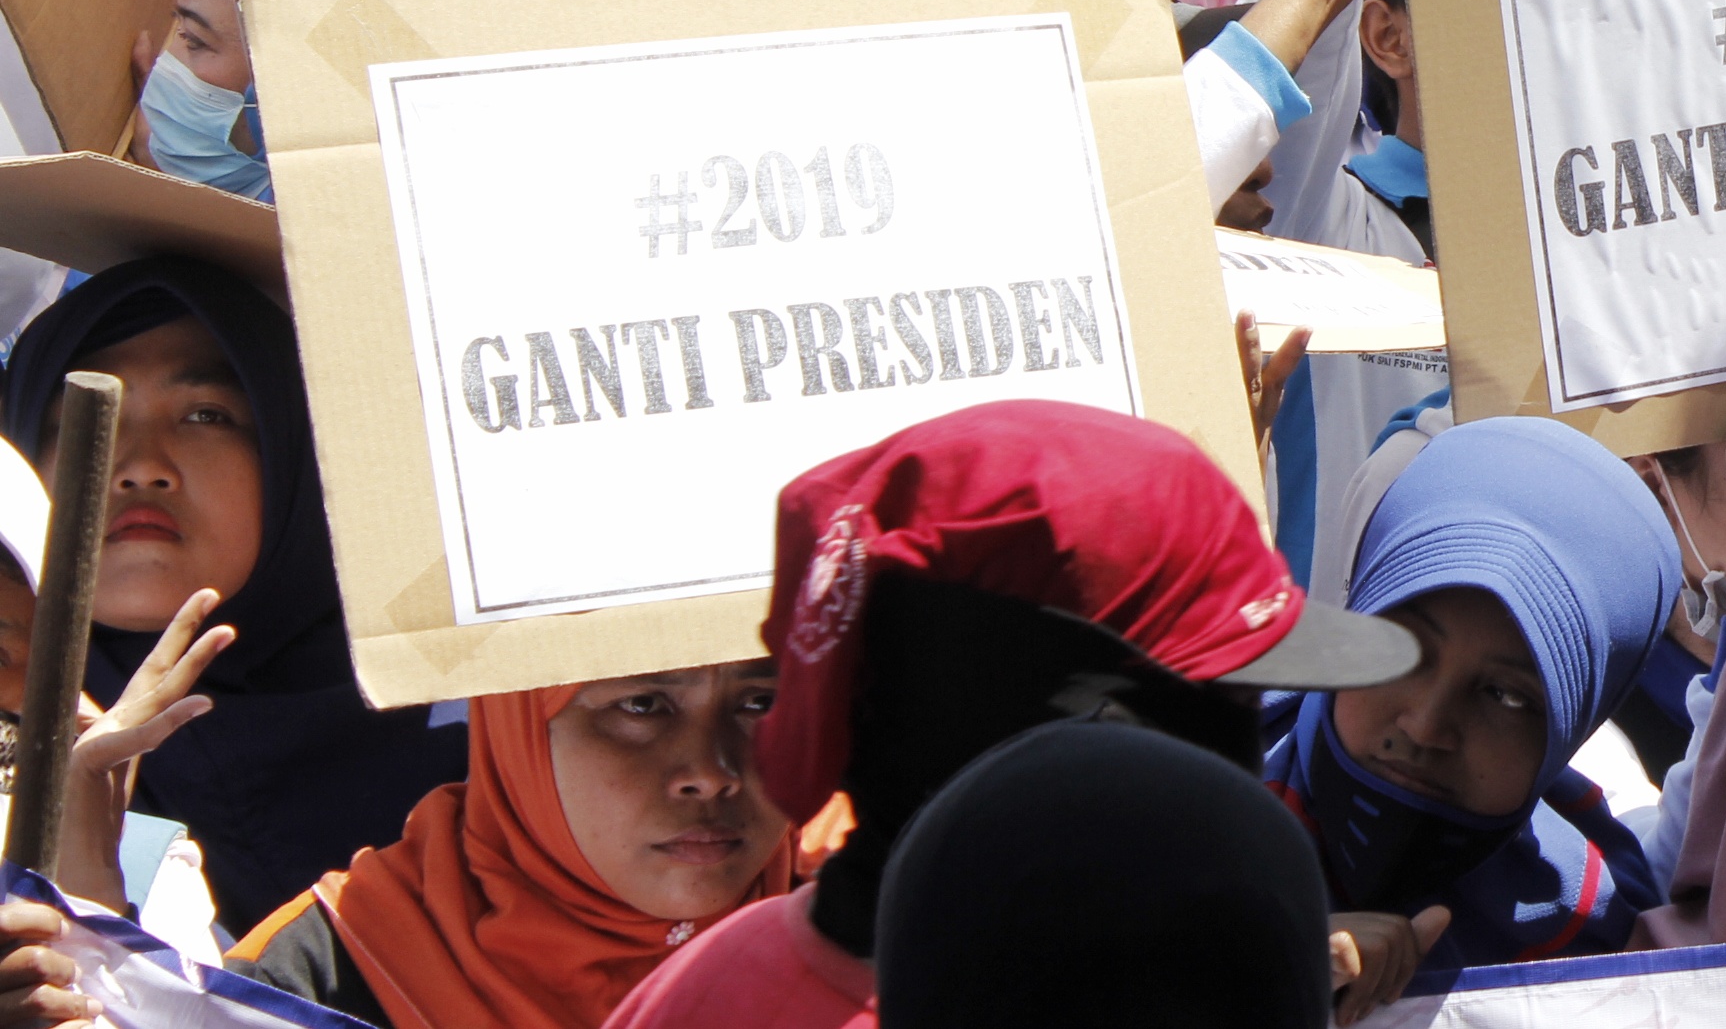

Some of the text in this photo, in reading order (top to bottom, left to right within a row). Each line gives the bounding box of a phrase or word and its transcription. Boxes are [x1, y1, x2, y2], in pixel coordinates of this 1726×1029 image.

[634, 142, 894, 260] #2019
[459, 275, 1106, 436] GANTI PRESIDEN
[1393, 358, 1422, 371] FSPMI
[1425, 363, 1438, 373] PT
